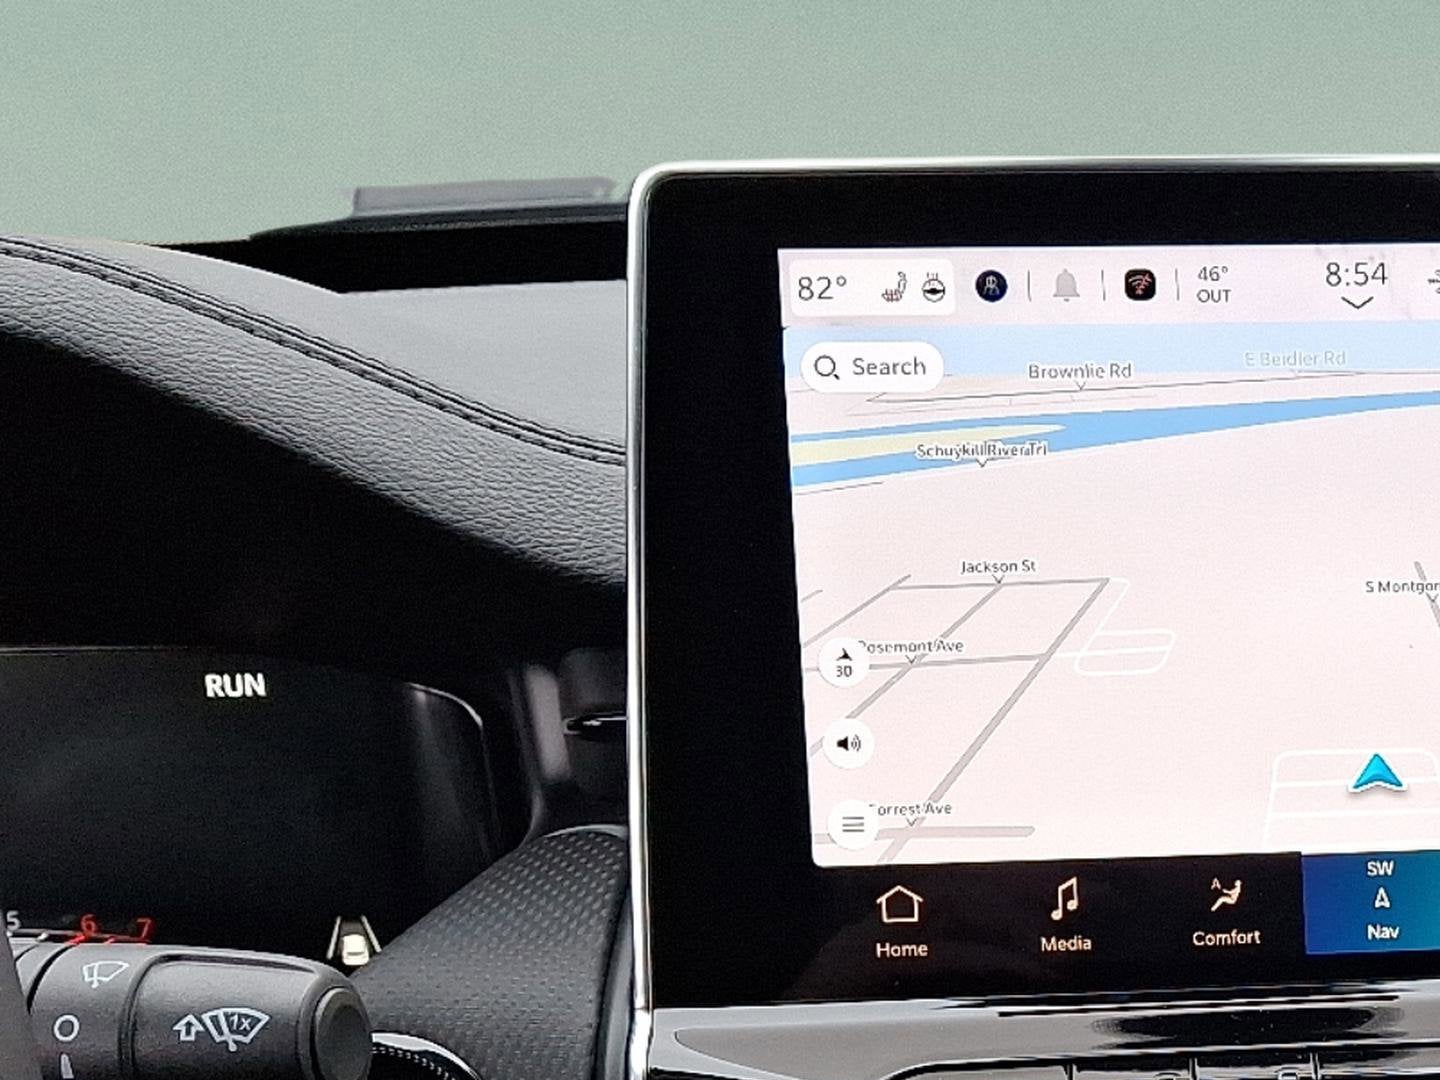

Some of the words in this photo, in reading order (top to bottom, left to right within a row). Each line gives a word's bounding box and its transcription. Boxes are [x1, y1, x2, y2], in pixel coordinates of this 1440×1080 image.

[1326, 263, 1387, 286] 8:54
[799, 276, 846, 301] 82°
[1197, 289, 1231, 303] OUT
[1324, 350, 1346, 365] Rd
[853, 357, 925, 375] Search
[1110, 363, 1131, 377] Rd
[961, 559, 1018, 575] Jackson
[1021, 559, 1036, 572] St
[1366, 581, 1374, 592] S
[936, 640, 965, 652] Ave
[205, 673, 265, 697] RUN
[868, 803, 921, 817] orrest
[924, 801, 954, 815] Ave
[1368, 861, 1393, 875] SW
[6, 911, 20, 931] 5
[80, 914, 97, 933] 6
[137, 918, 152, 936] 7
[1193, 929, 1260, 945] Comfort
[1368, 925, 1399, 939] Nav
[877, 943, 928, 957] Home
[1041, 936, 1091, 951] Media
